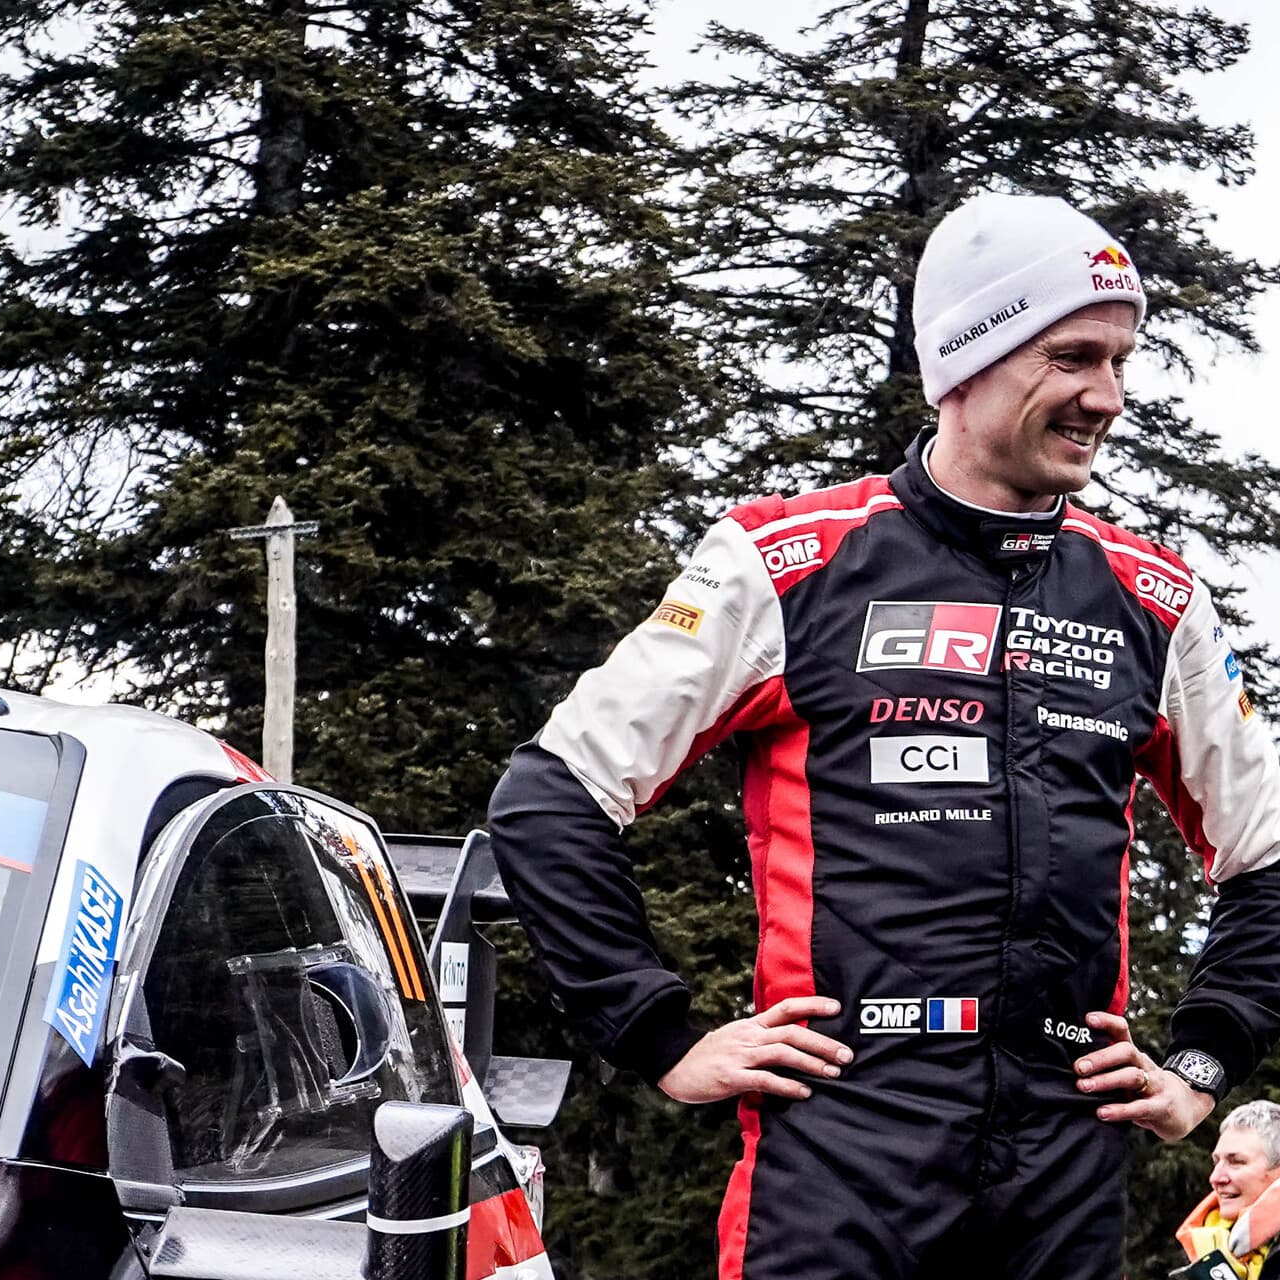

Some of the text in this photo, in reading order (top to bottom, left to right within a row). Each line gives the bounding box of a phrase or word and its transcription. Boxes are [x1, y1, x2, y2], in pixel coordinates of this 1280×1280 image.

[1092, 274, 1124, 291] Red
[938, 298, 1029, 358] RICHARD MILLE
[765, 538, 821, 572] OMP
[1135, 573, 1189, 609] OMP
[1010, 606, 1125, 647] TOYOTA
[865, 628, 989, 669] GR
[1006, 630, 1114, 665] GAZOO
[1000, 651, 1112, 690] Racing
[870, 697, 984, 724] DENSO
[1037, 705, 1129, 742] Panasonic
[875, 808, 992, 825] RICHARD MILLE
[56, 866, 117, 1054] AsahiKASEI
[860, 1004, 921, 1028] OMP
[1057, 1021, 1092, 1043] OGIR
